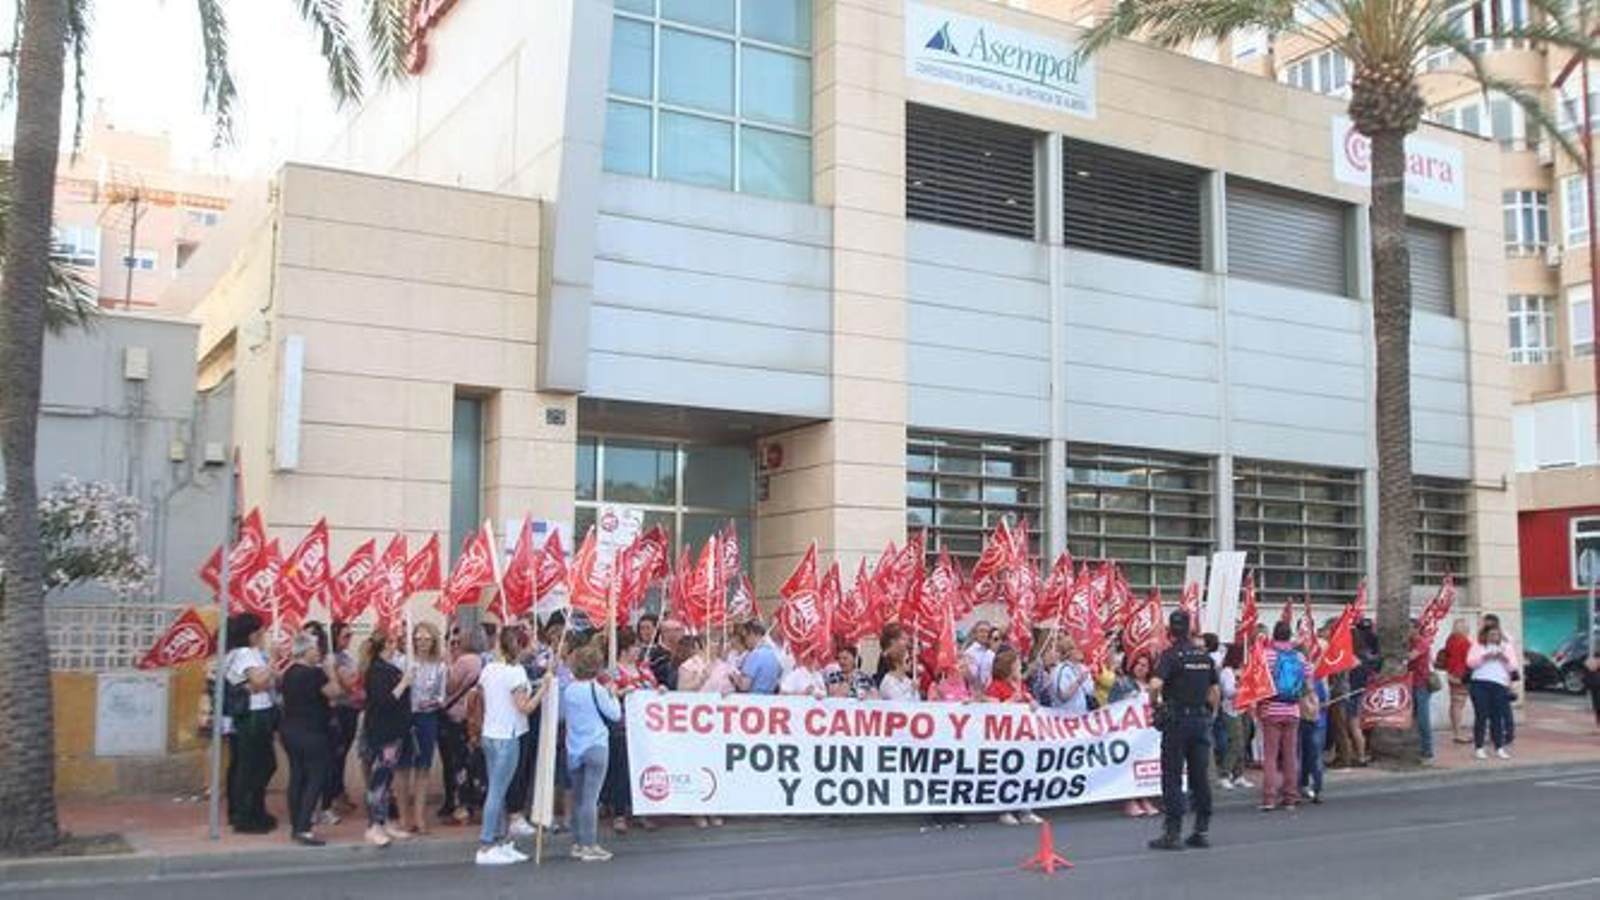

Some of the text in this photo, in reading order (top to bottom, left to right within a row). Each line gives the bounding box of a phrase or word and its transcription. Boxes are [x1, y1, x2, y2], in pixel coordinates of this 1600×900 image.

[967, 27, 1079, 85] Asempal
[644, 703, 792, 735] SECTOR
[805, 708, 936, 739] CAMPO
[949, 713, 971, 740] Y
[725, 743, 799, 773] POR
[814, 745, 864, 773] UN
[878, 746, 1024, 775] EMPLEO
[1035, 739, 1130, 773] DIGNO
[778, 774, 1087, 807] Y CON DERECHOS
